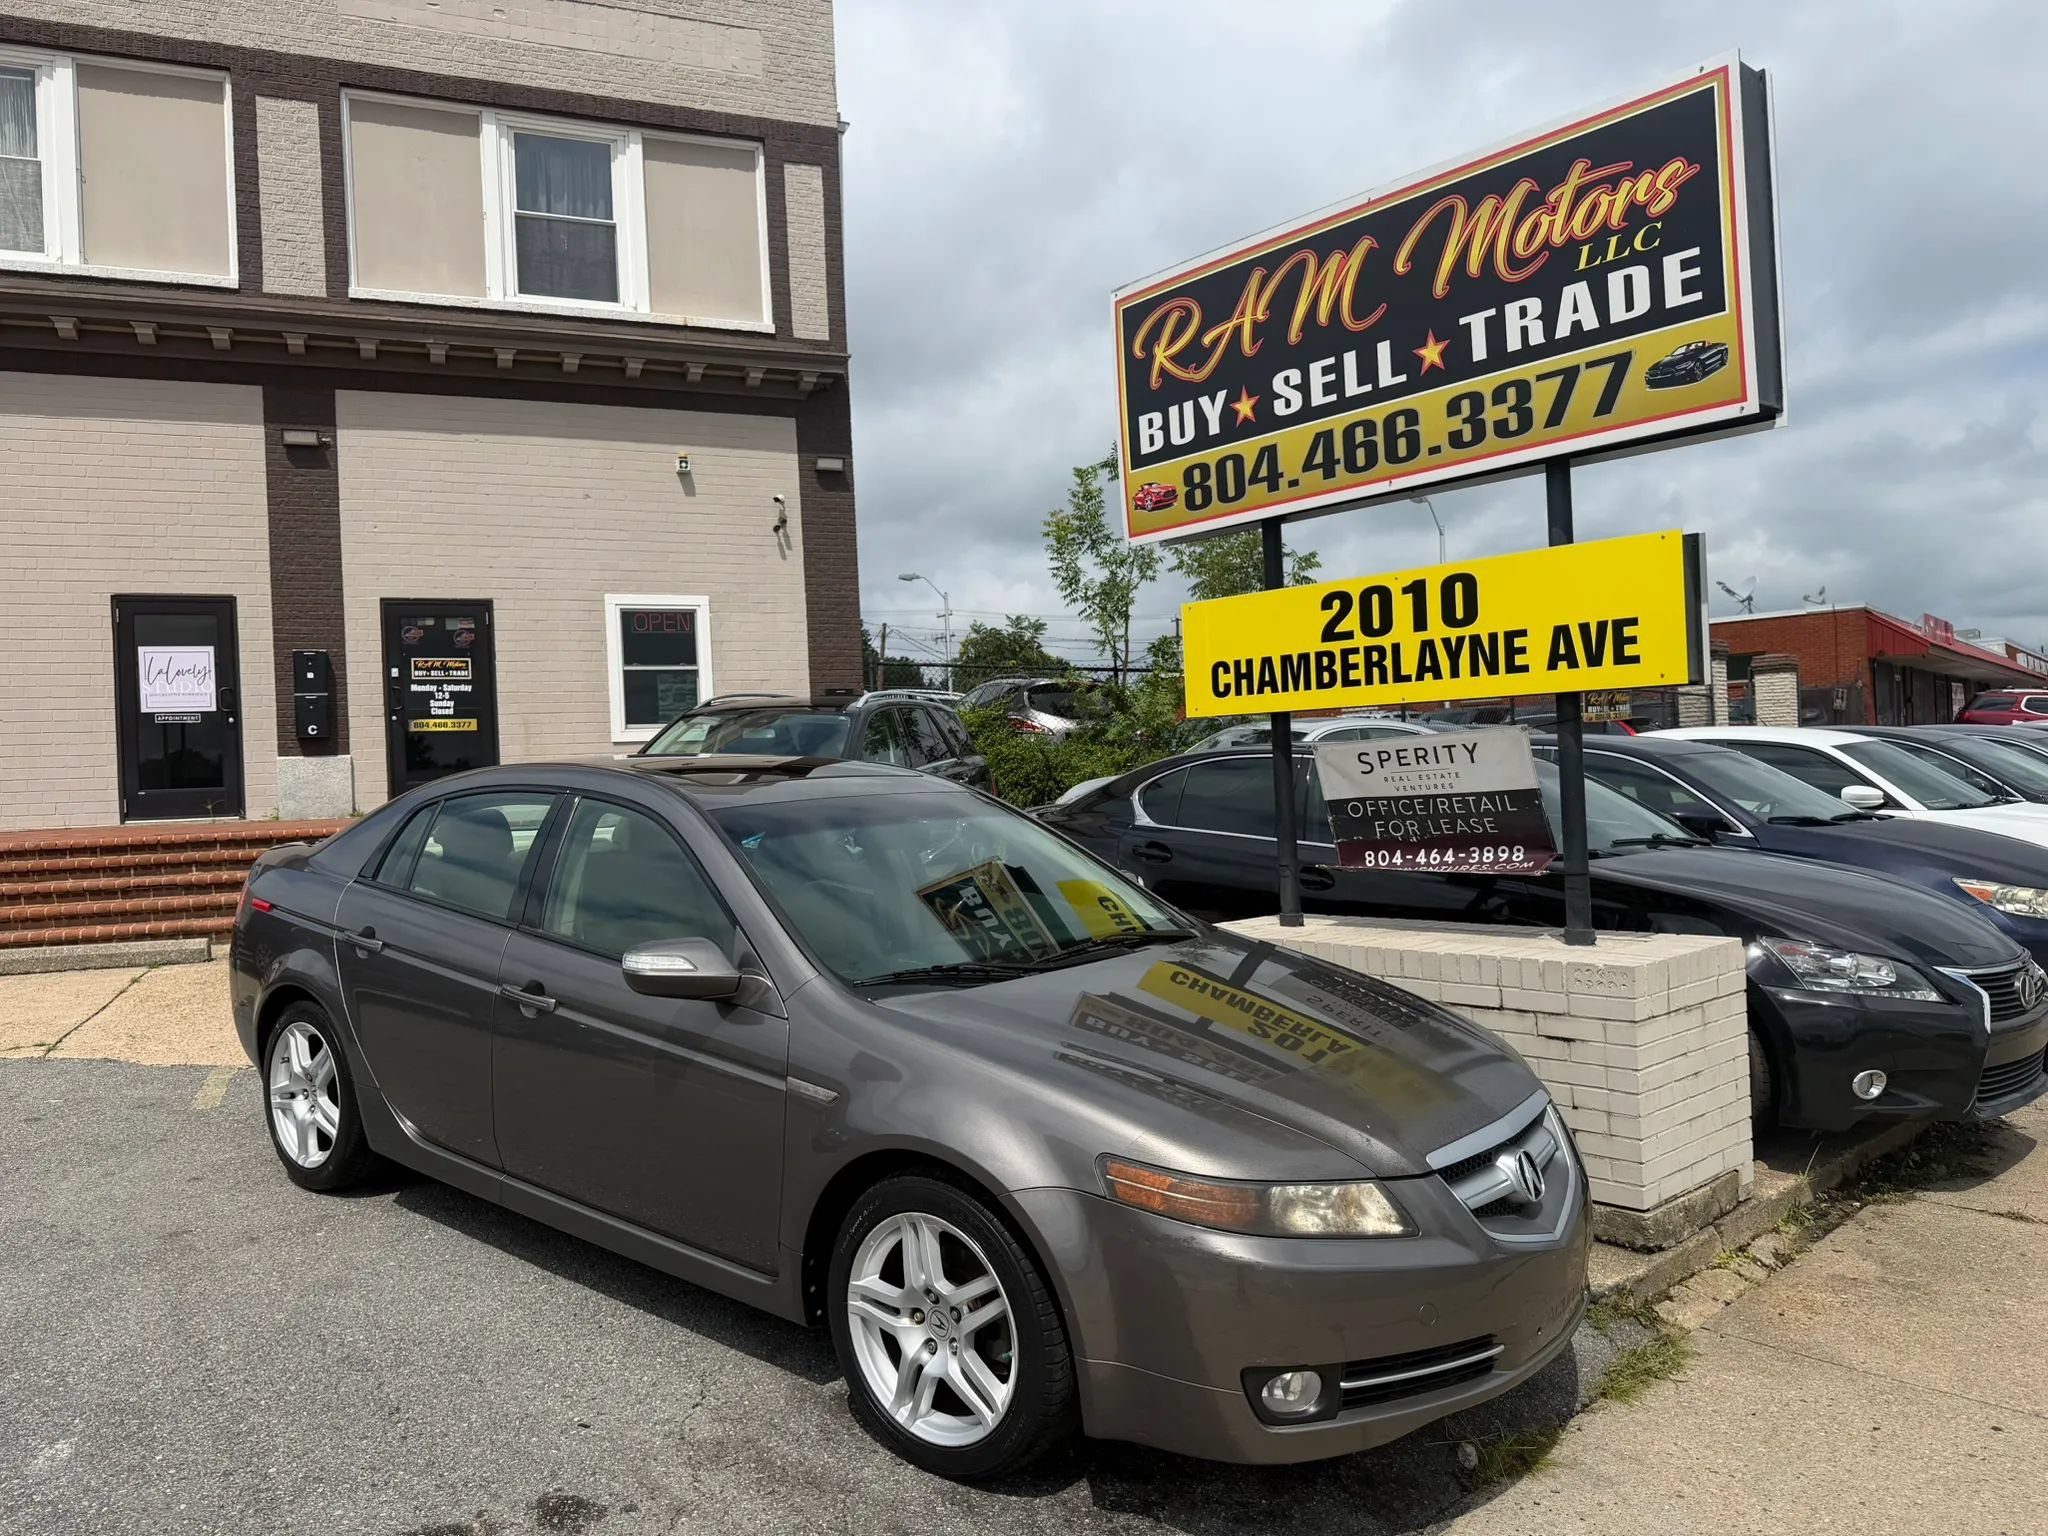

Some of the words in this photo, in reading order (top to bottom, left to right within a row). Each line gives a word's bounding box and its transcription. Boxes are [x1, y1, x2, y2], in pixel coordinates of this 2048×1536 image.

[1574, 222, 1662, 272] LLC
[1133, 236, 1387, 389] RAM
[1394, 157, 1700, 299] Motors
[1138, 389, 1228, 455] BUY
[1272, 339, 1407, 416] SELL
[1459, 247, 1703, 362] TRADE
[1183, 349, 1634, 512] 804.466.3377
[1320, 572, 1480, 643] 2010
[634, 612, 690, 632] OPEN
[1211, 628, 1530, 699] CHAMBERLAYNE
[1546, 616, 1641, 672] AVE
[410, 684, 437, 692] Monday
[443, 684, 472, 692] Saturday
[431, 707, 454, 715] Closed
[307, 725, 318, 735] C
[1357, 742, 1478, 775] SPERITY
[1384, 775, 1411, 783] REAL
[1418, 772, 1461, 781] ESTATE
[1394, 782, 1455, 792] VENTURES
[1347, 795, 1518, 818] OFFICE/RETAIL
[1375, 820, 1420, 838] FOR
[1428, 817, 1499, 835] LEASE
[1365, 845, 1525, 867] 804-464-3898
[1402, 861, 1535, 872] VENTURES.COM
